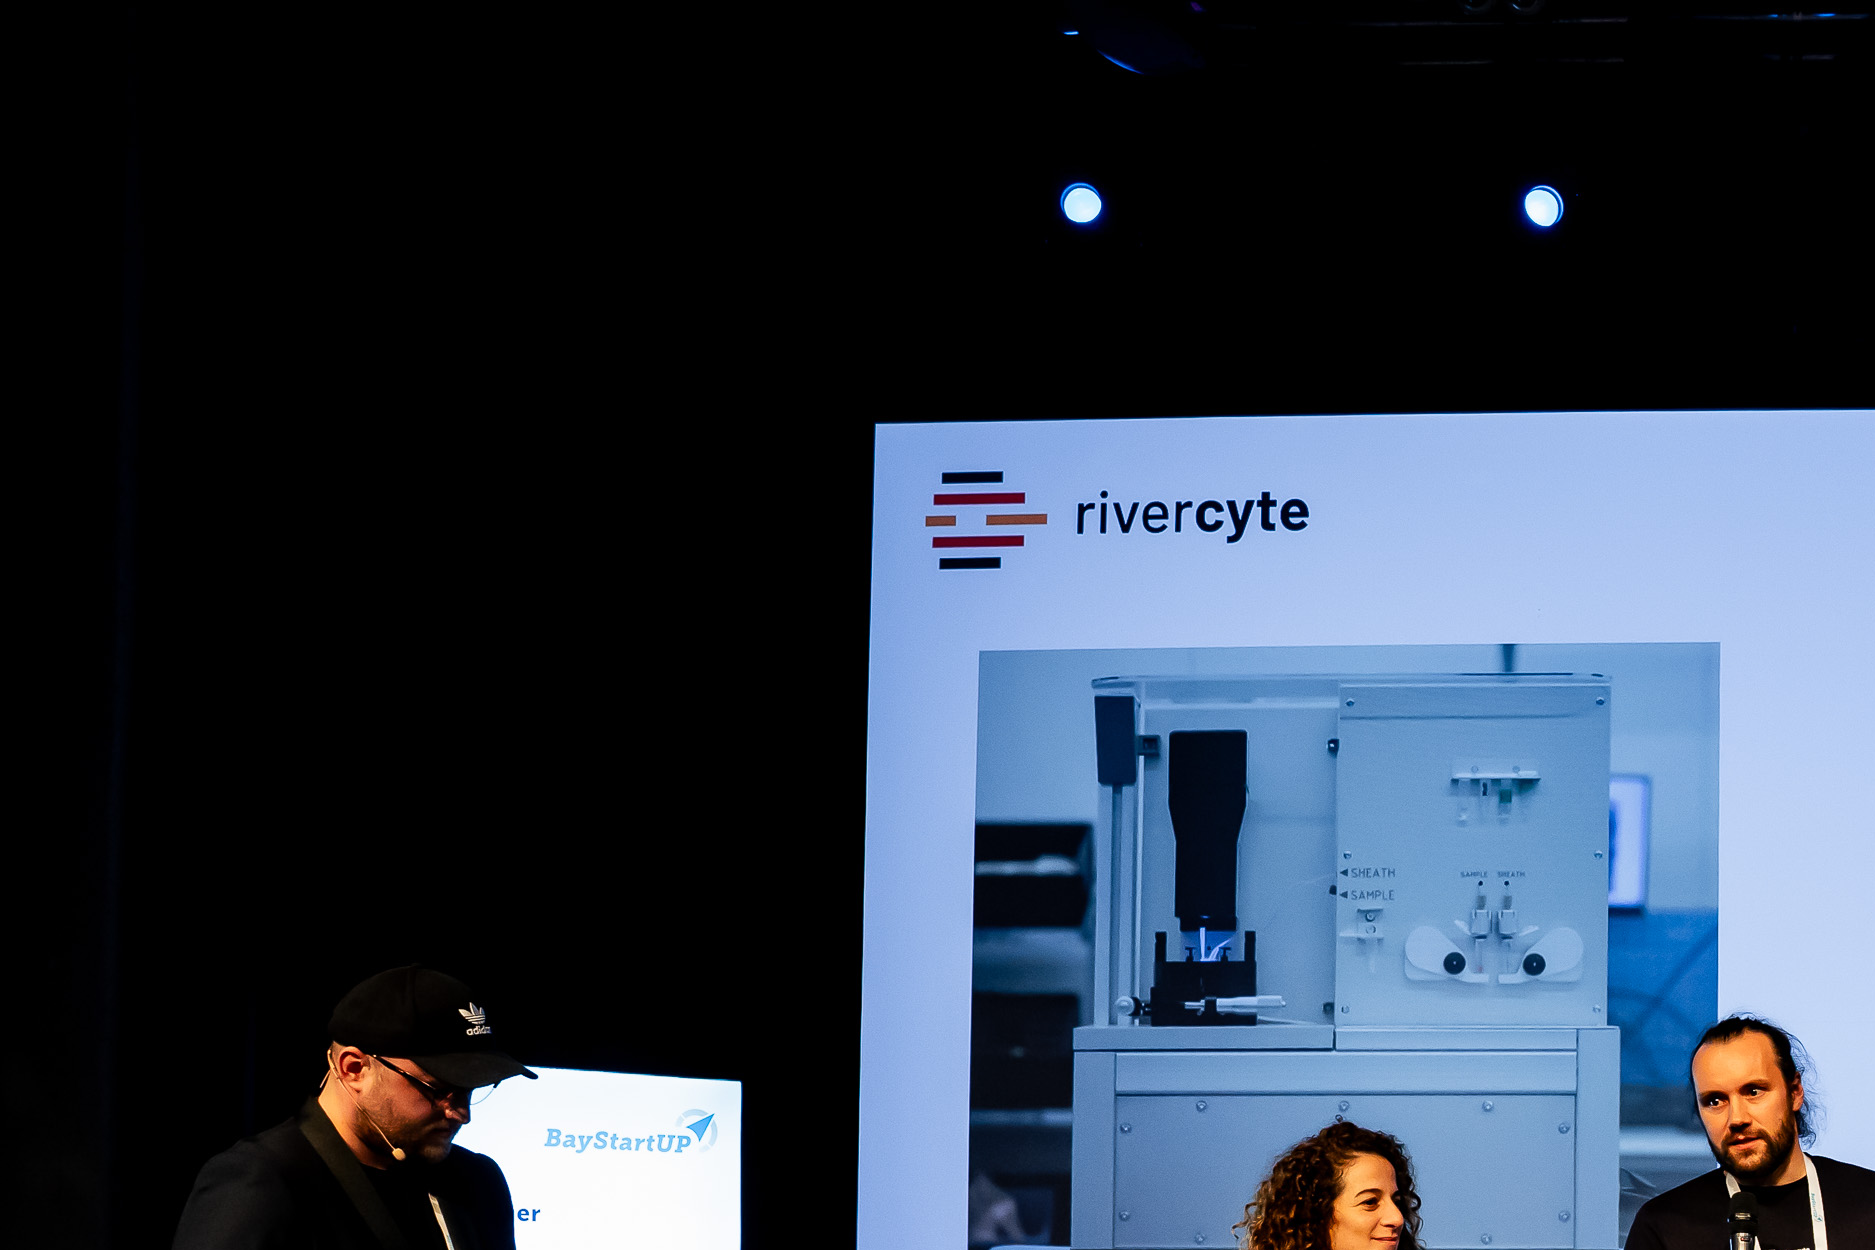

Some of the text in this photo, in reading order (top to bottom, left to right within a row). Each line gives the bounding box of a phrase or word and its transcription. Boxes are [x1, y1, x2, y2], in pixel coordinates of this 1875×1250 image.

[1076, 489, 1310, 544] rivercyte
[1350, 867, 1396, 879] SHEATH
[1350, 889, 1395, 901] SAMPLE
[543, 1127, 691, 1154] BayStartUP
